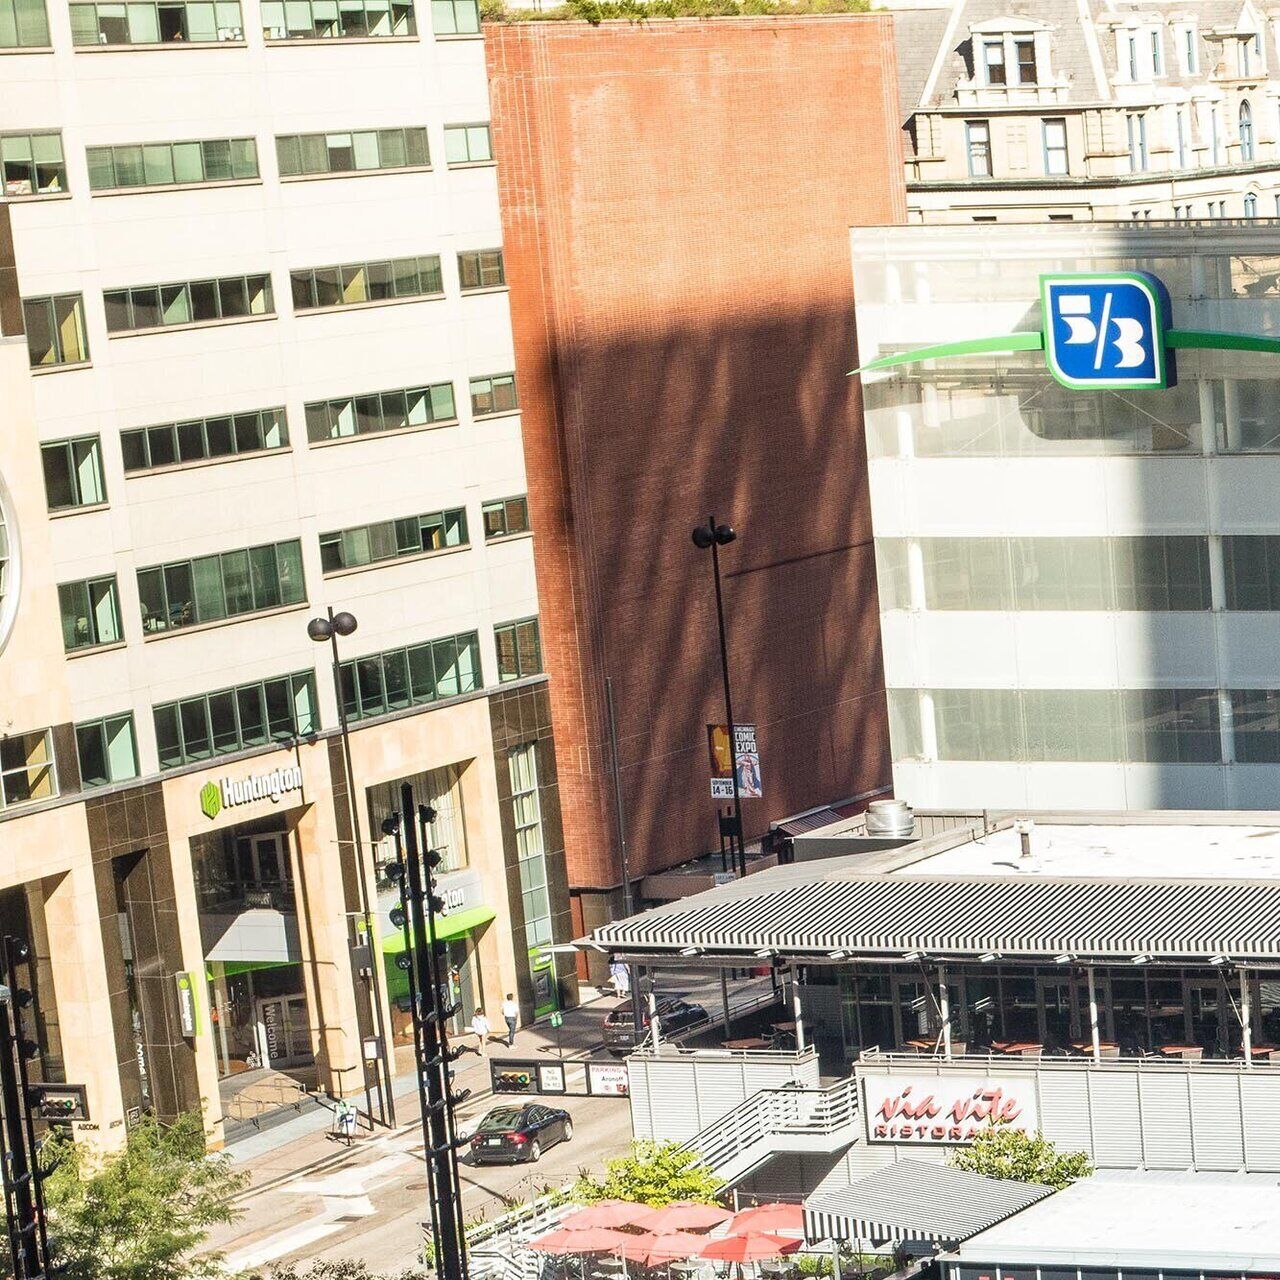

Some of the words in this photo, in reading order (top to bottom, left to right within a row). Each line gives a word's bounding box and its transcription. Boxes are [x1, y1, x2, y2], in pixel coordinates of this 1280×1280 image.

[734, 732, 756, 742] COMIC
[735, 742, 757, 753] EXPO
[222, 767, 302, 807] Huntington
[264, 1004, 279, 1059] Welcome
